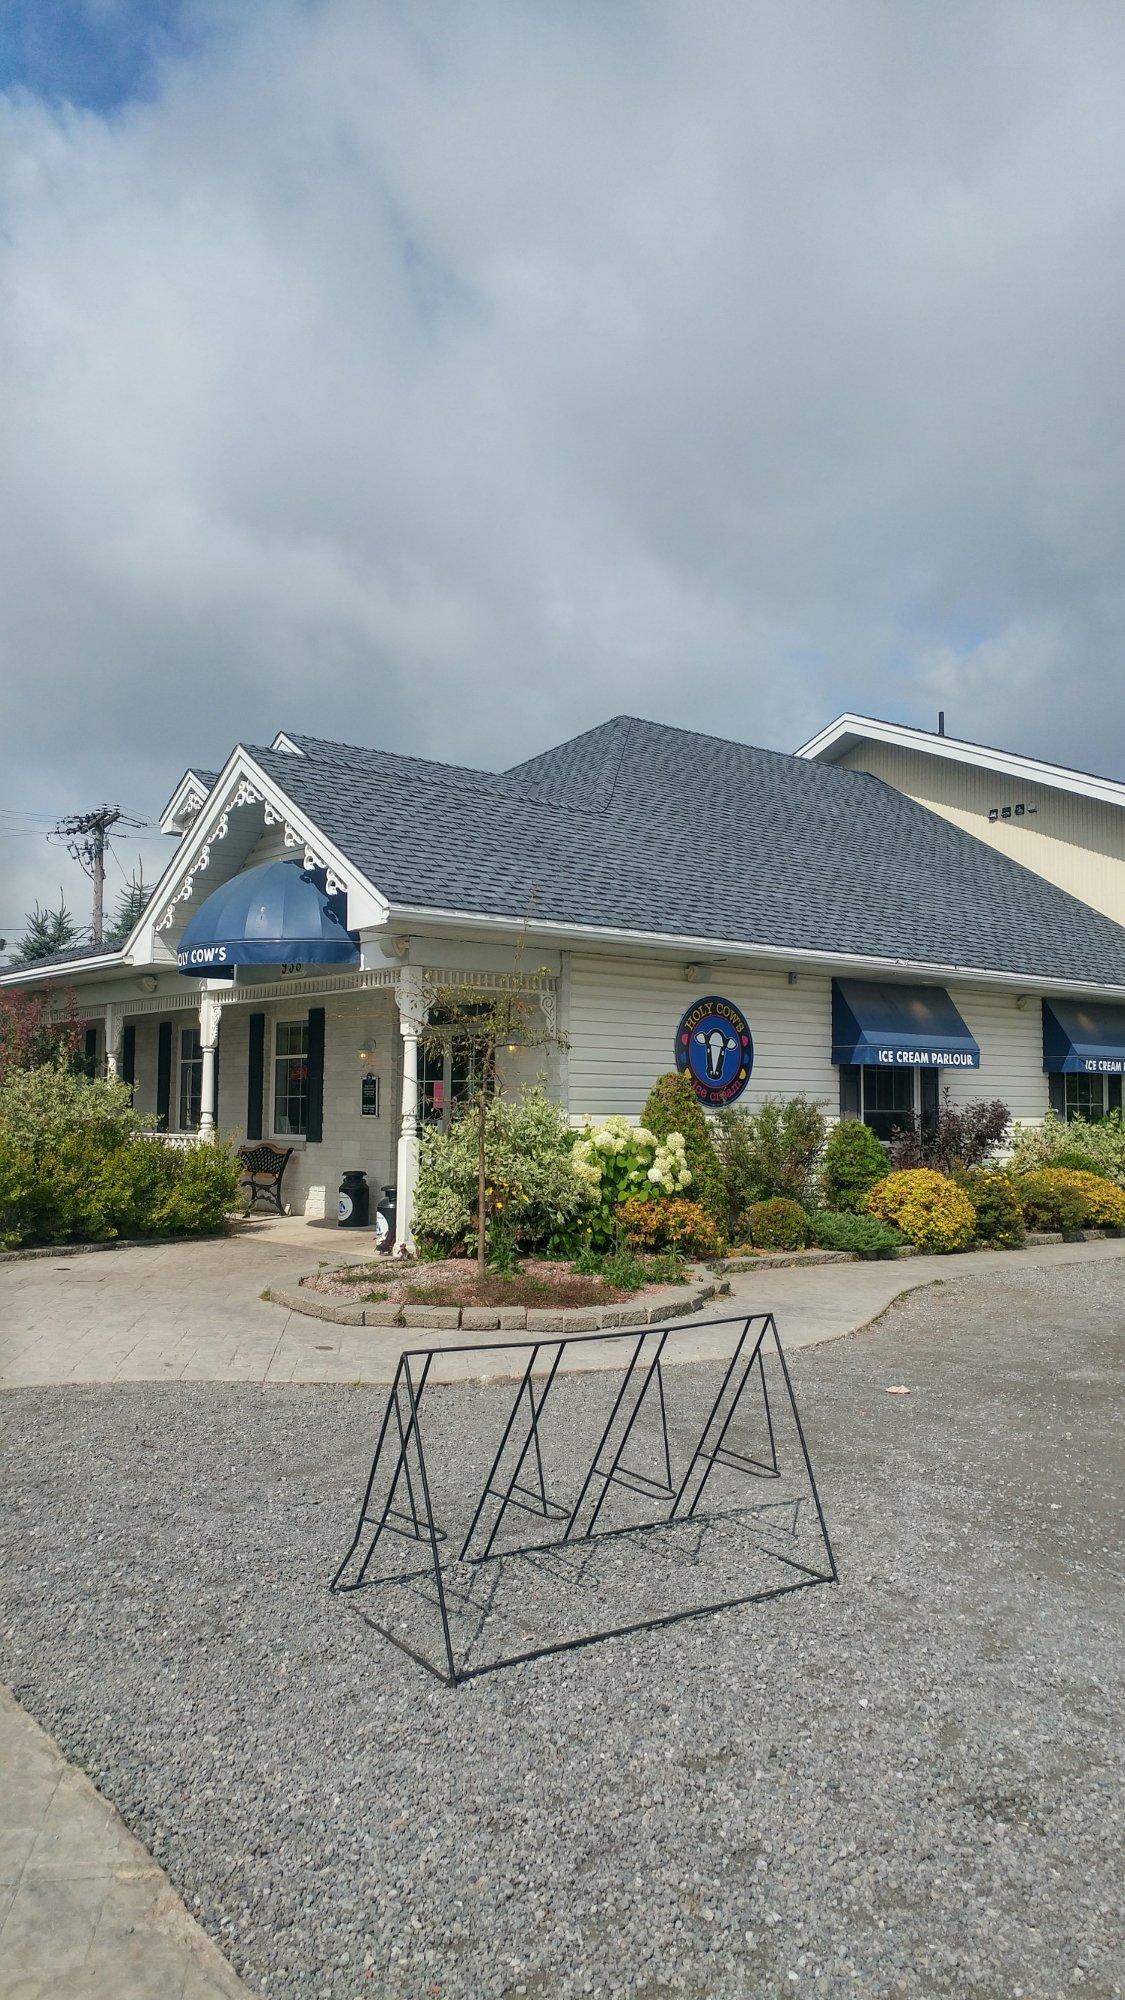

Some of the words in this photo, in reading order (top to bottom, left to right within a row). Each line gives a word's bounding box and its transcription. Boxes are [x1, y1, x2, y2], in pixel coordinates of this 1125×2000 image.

[178, 953, 189, 966] OLY
[191, 947, 226, 963] COW'S
[685, 1002, 713, 1030] HOLY
[879, 1051, 893, 1062] ICE
[897, 1051, 929, 1063] CREAM
[932, 1053, 973, 1065] PARLOUR
[1085, 1060, 1096, 1070] ICE
[1098, 1060, 1121, 1071] CREAM
